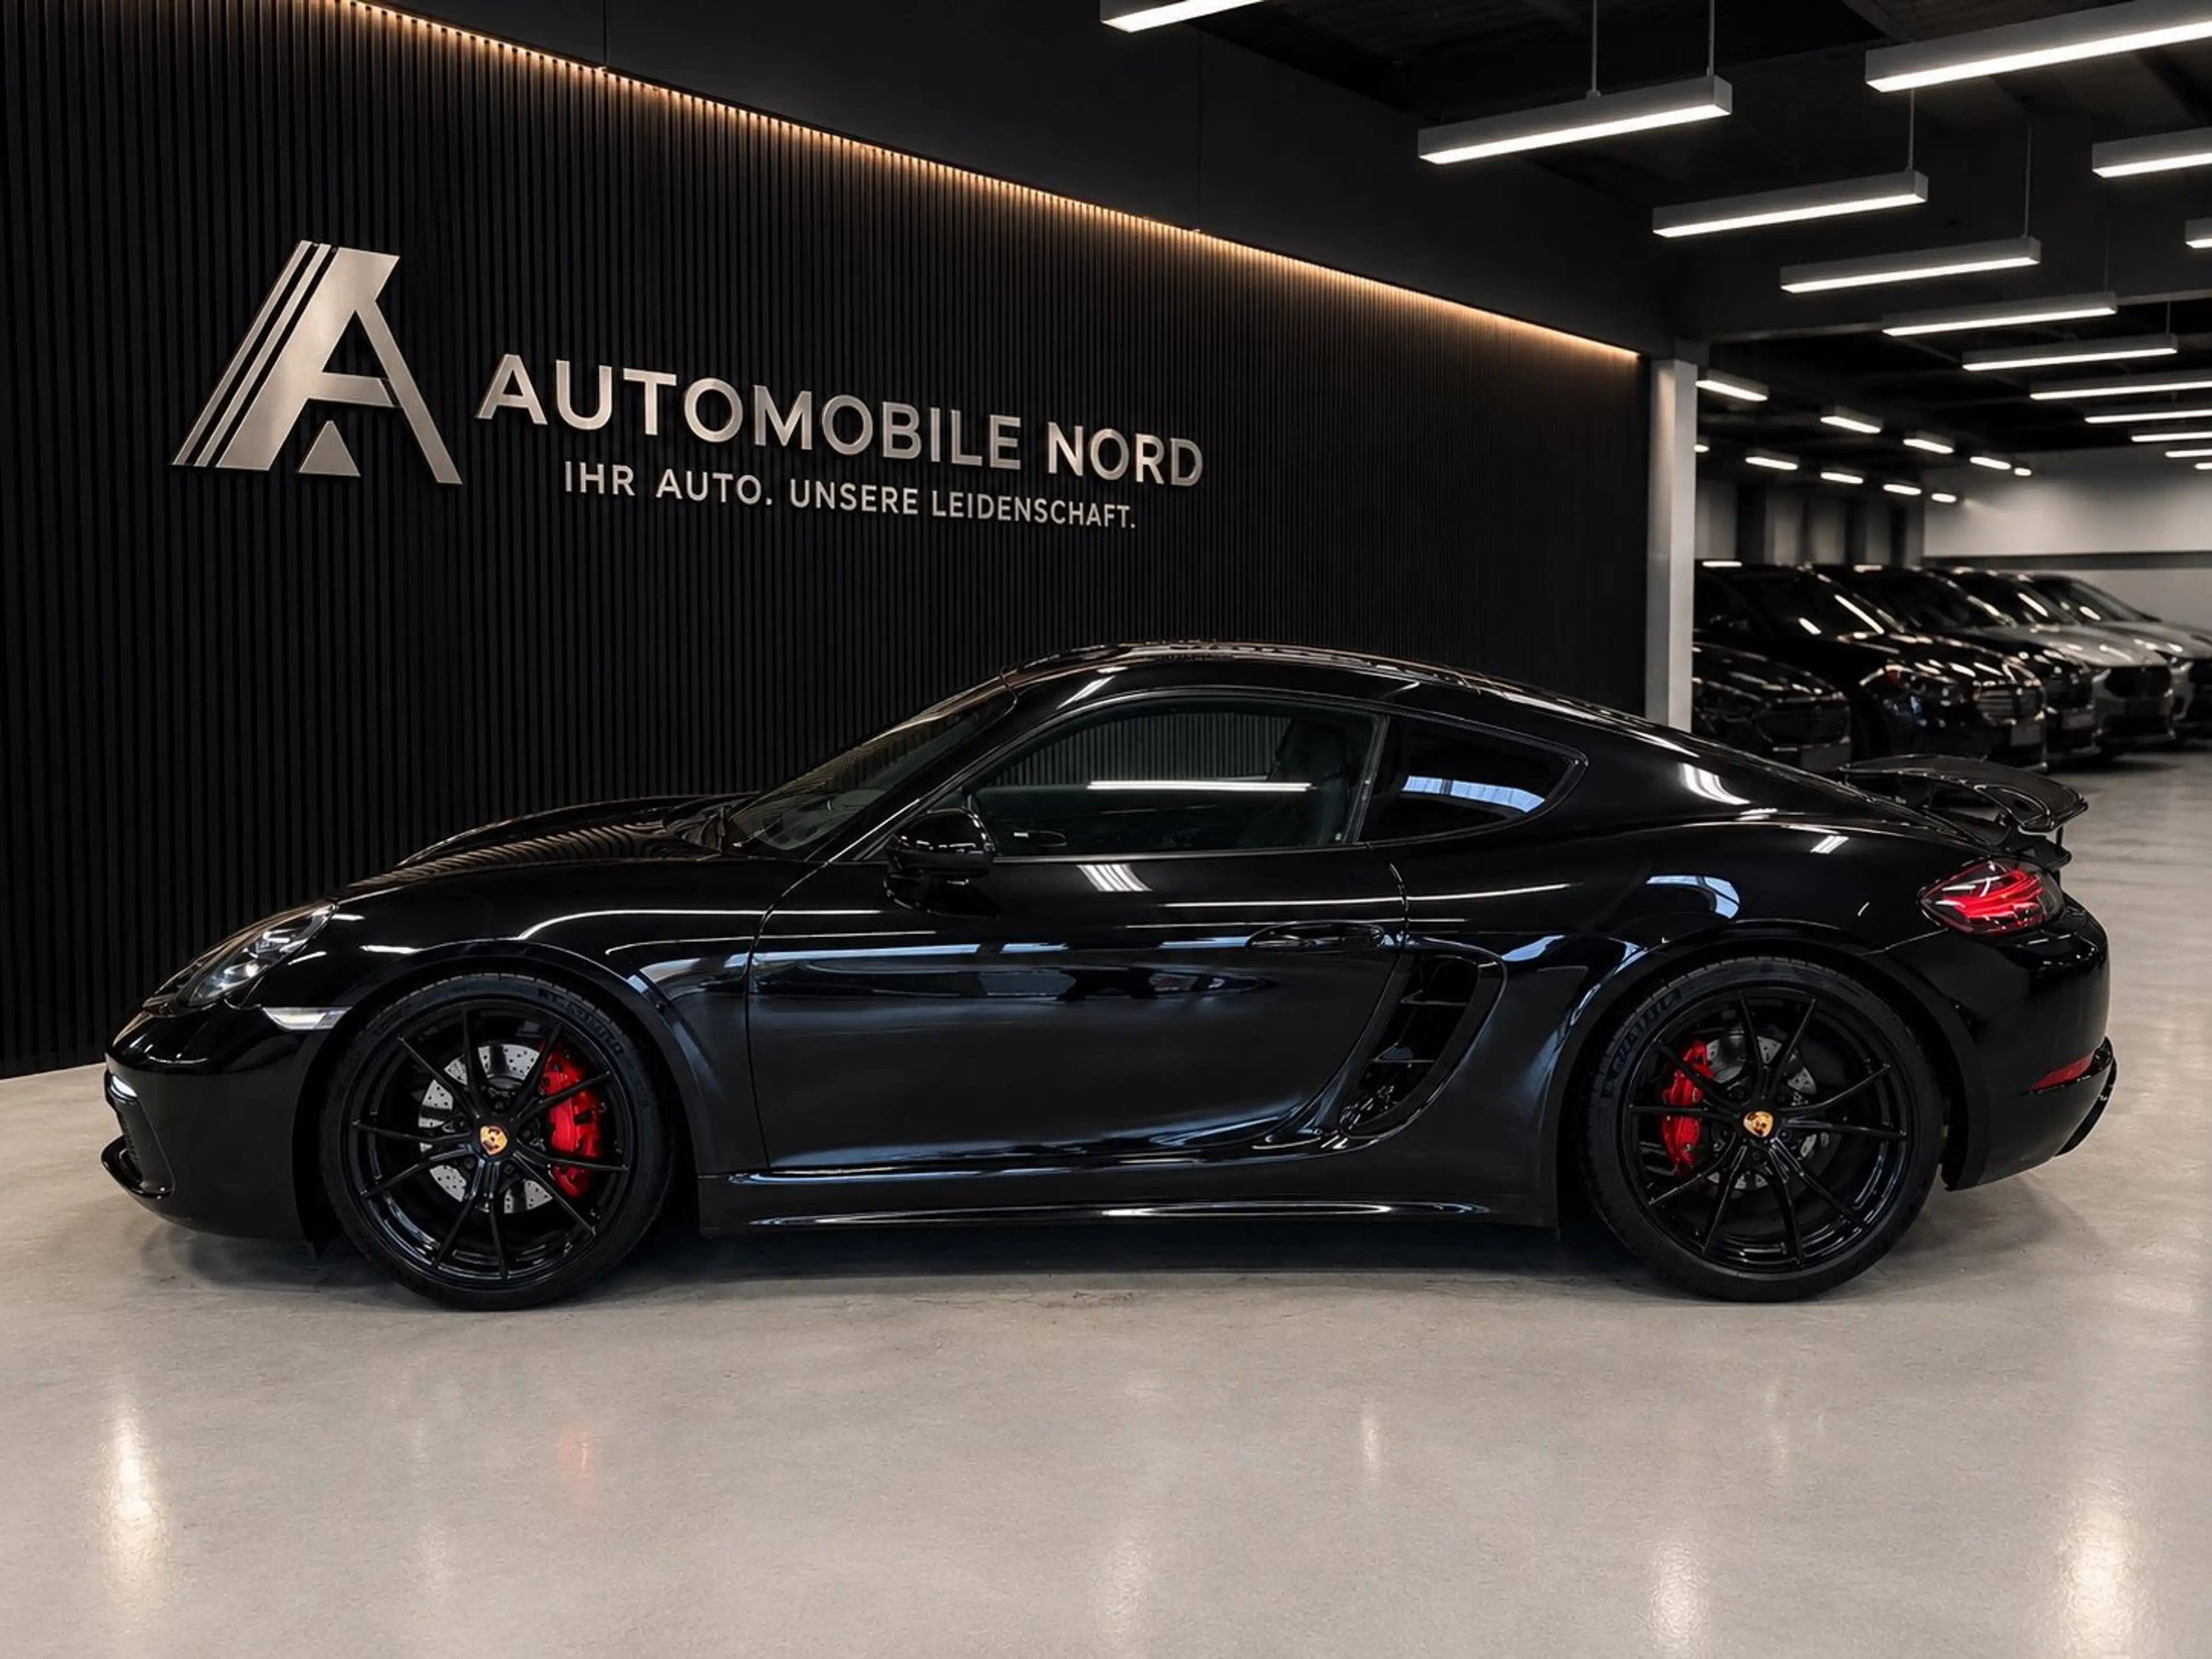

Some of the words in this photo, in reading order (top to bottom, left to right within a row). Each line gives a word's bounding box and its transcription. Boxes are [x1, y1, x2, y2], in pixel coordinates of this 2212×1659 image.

[475, 353, 1021, 471] AUTOMOBILE
[1047, 421, 1203, 487] NORD
[565, 461, 635, 496] IHR
[655, 468, 773, 506] AUTO.
[790, 478, 919, 515] UNSERE
[931, 490, 1136, 529] LEIDENSCHAFT.
